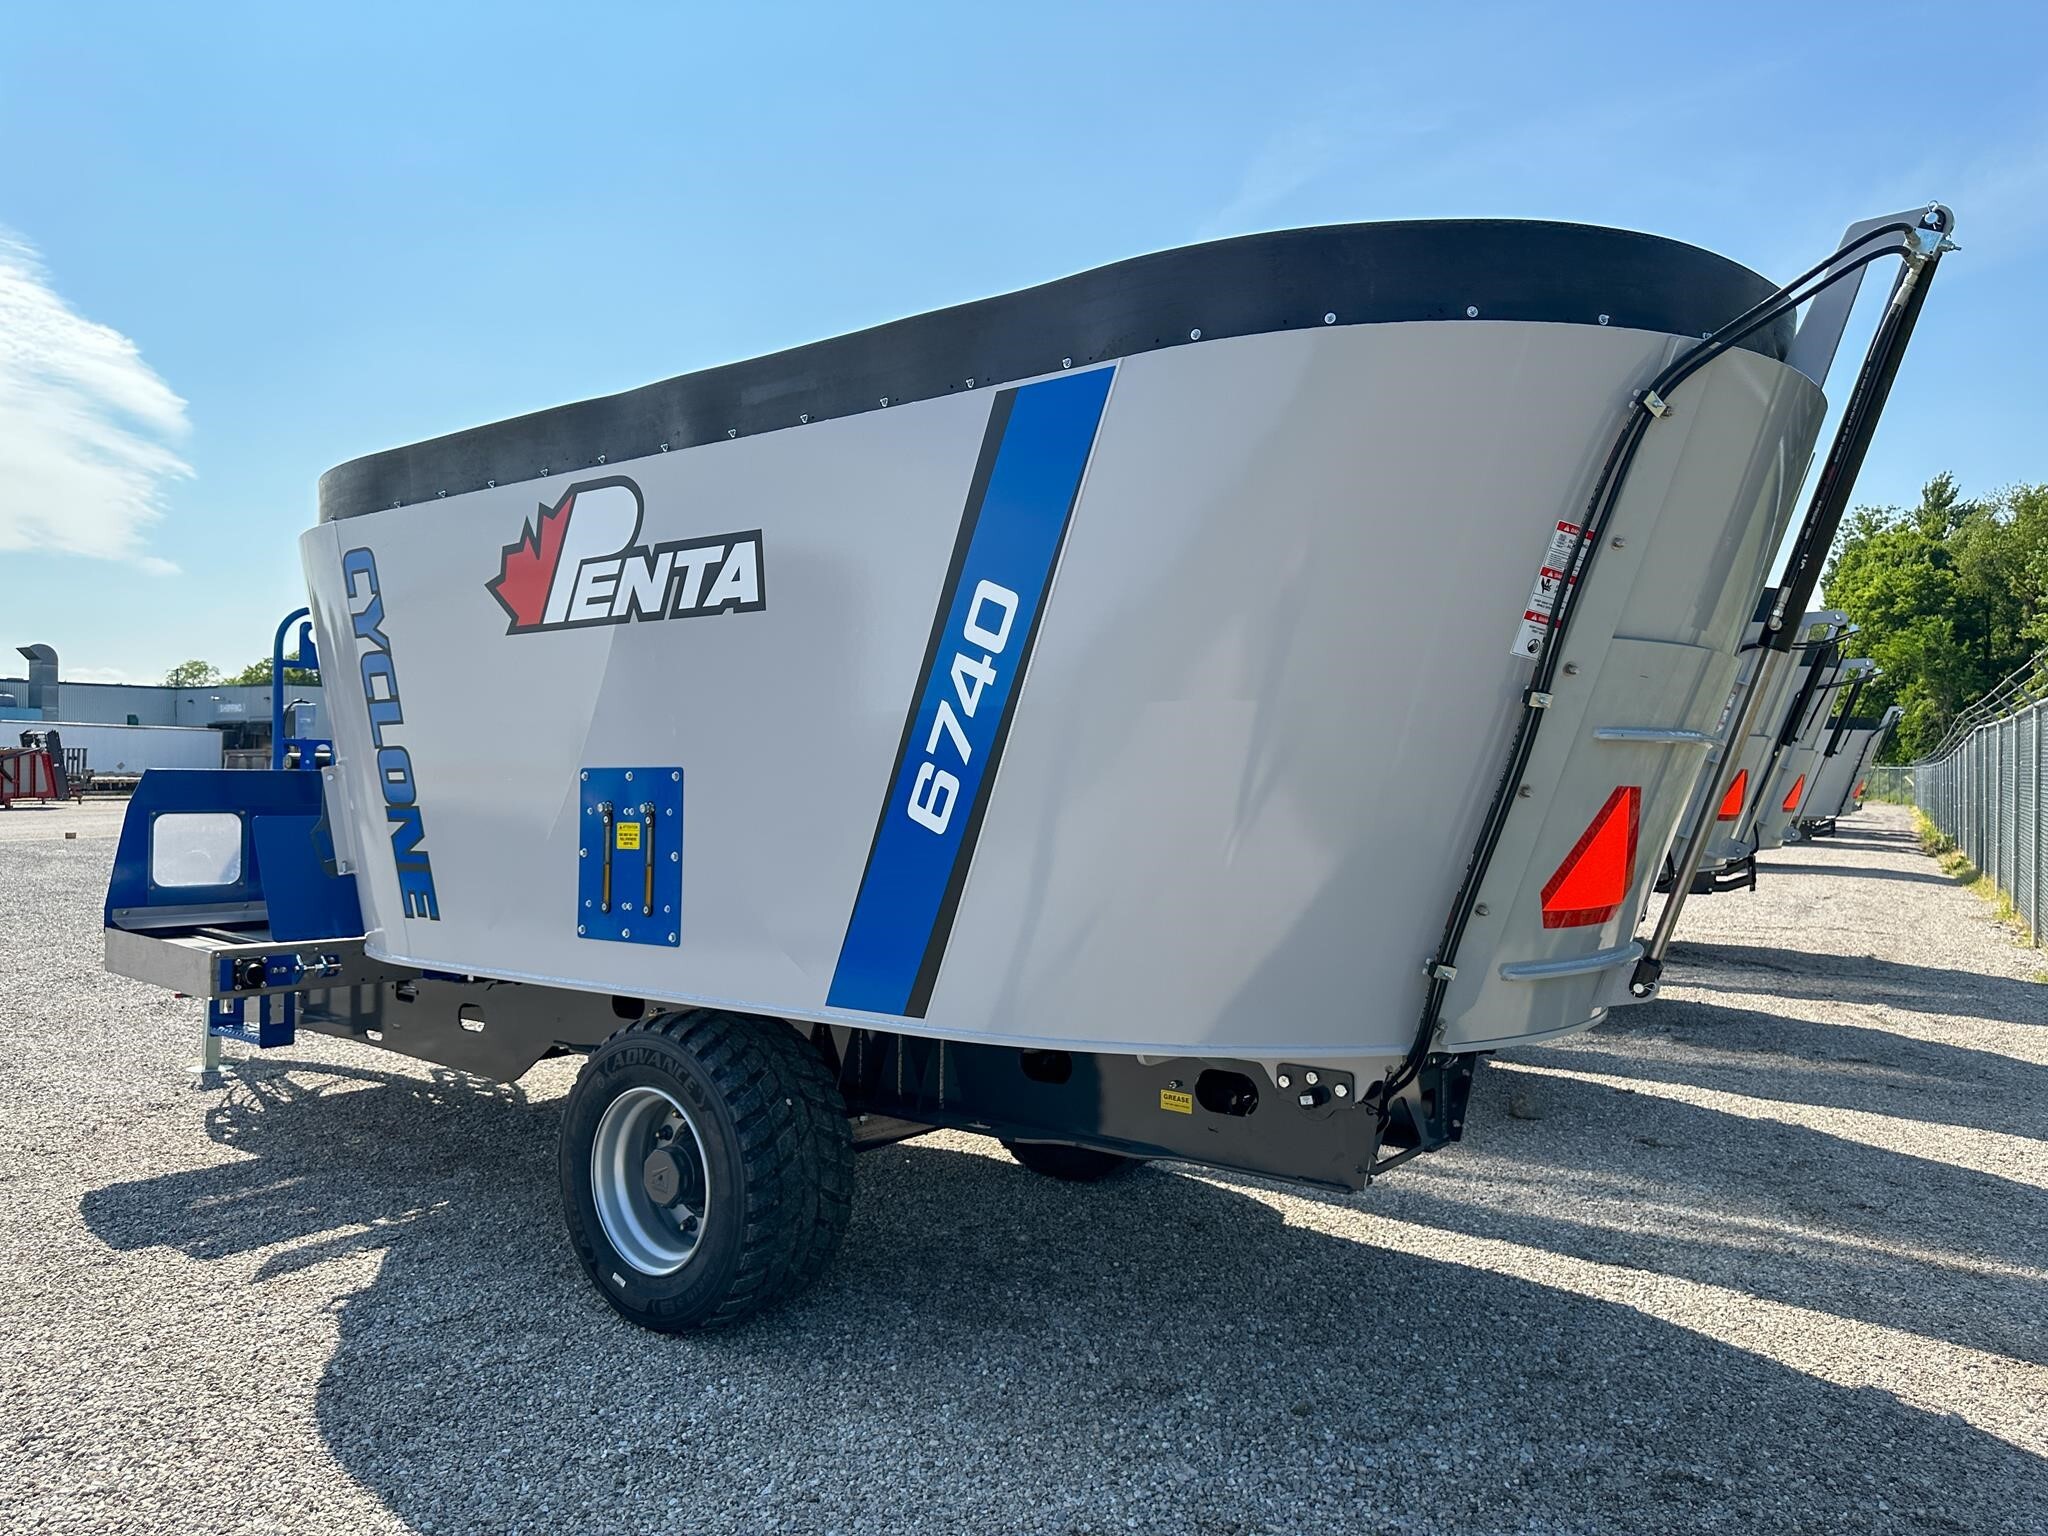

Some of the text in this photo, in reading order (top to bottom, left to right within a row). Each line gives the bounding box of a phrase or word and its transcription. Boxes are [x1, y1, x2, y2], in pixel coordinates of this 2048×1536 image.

[541, 480, 763, 627] PENTA
[342, 546, 441, 921] CYCLONE
[906, 578, 1020, 836] 6740
[612, 1047, 698, 1093] ADVANCE
[1163, 1093, 1190, 1103] GREASE
